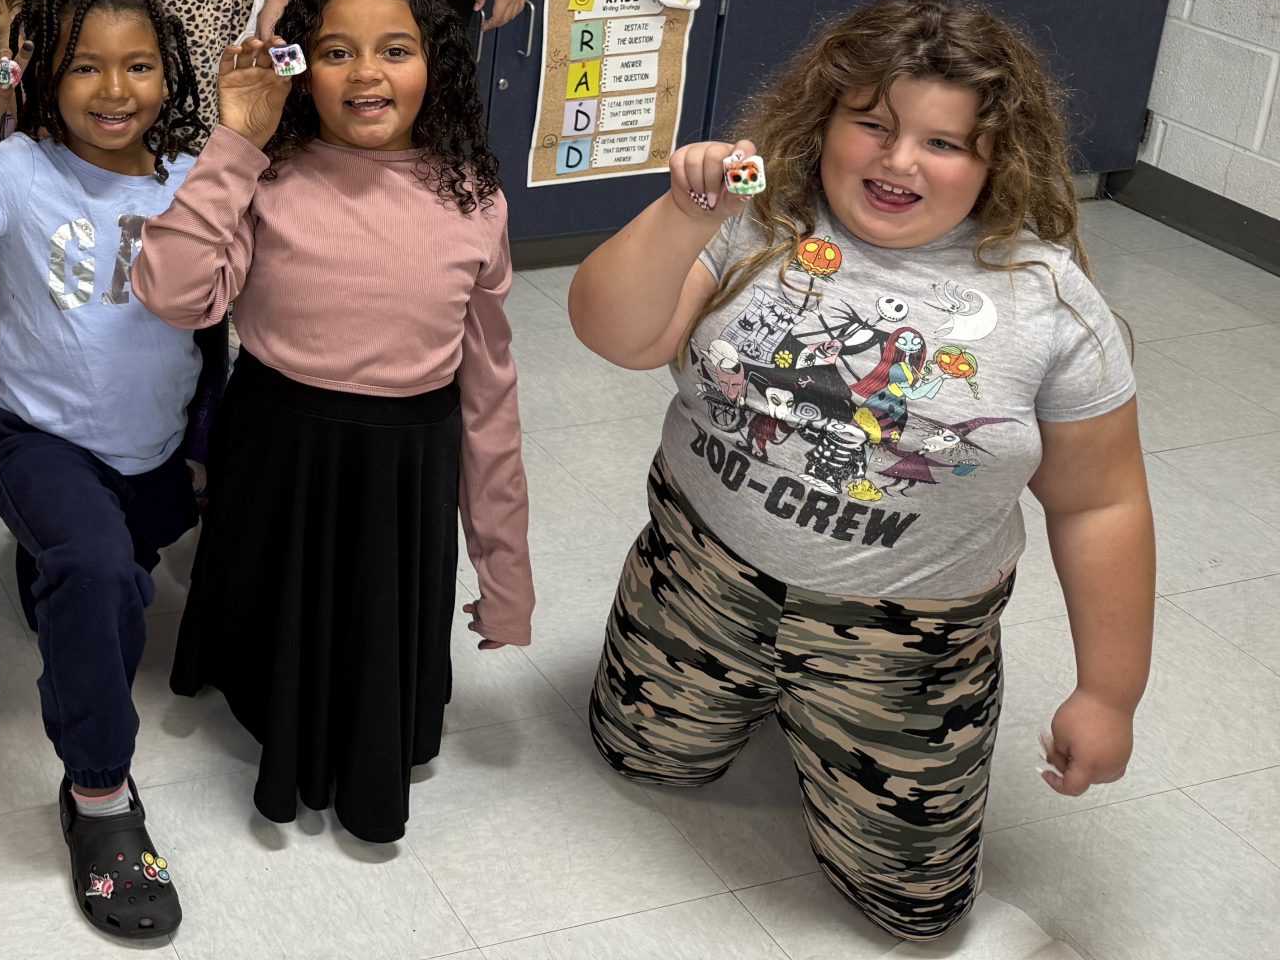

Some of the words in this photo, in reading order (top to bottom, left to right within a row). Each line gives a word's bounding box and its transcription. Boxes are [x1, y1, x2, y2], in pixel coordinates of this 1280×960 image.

[620, 3, 640, 11] Strategy
[580, 29, 594, 52] R
[624, 23, 649, 31] RESTATE
[628, 36, 653, 44] QUESTION
[574, 71, 590, 93] A
[620, 60, 642, 69] ANSWER
[624, 73, 649, 82] QUESTION
[574, 109, 590, 132] D
[566, 146, 582, 169] D
